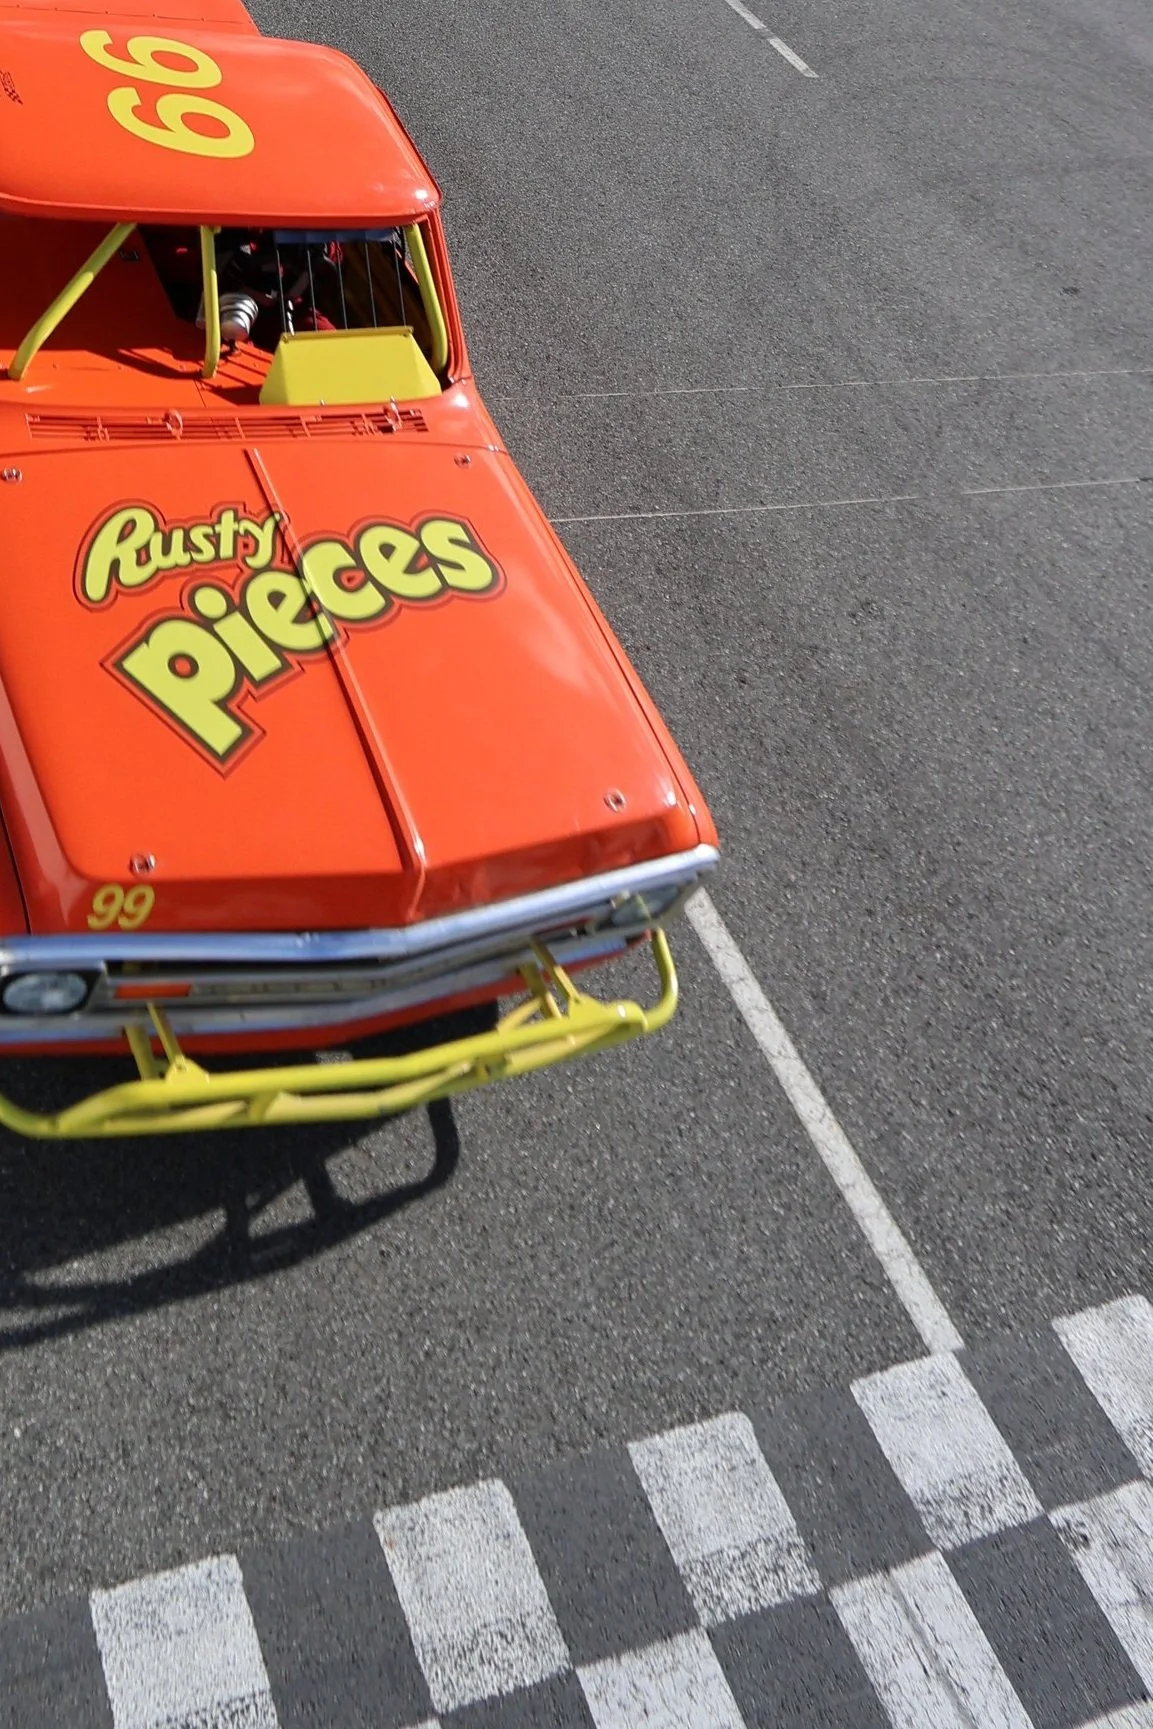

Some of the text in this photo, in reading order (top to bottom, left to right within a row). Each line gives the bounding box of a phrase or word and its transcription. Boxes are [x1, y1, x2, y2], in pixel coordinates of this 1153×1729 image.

[78, 28, 256, 159] 99
[84, 504, 282, 603] Rusty
[86, 882, 156, 931] 99
